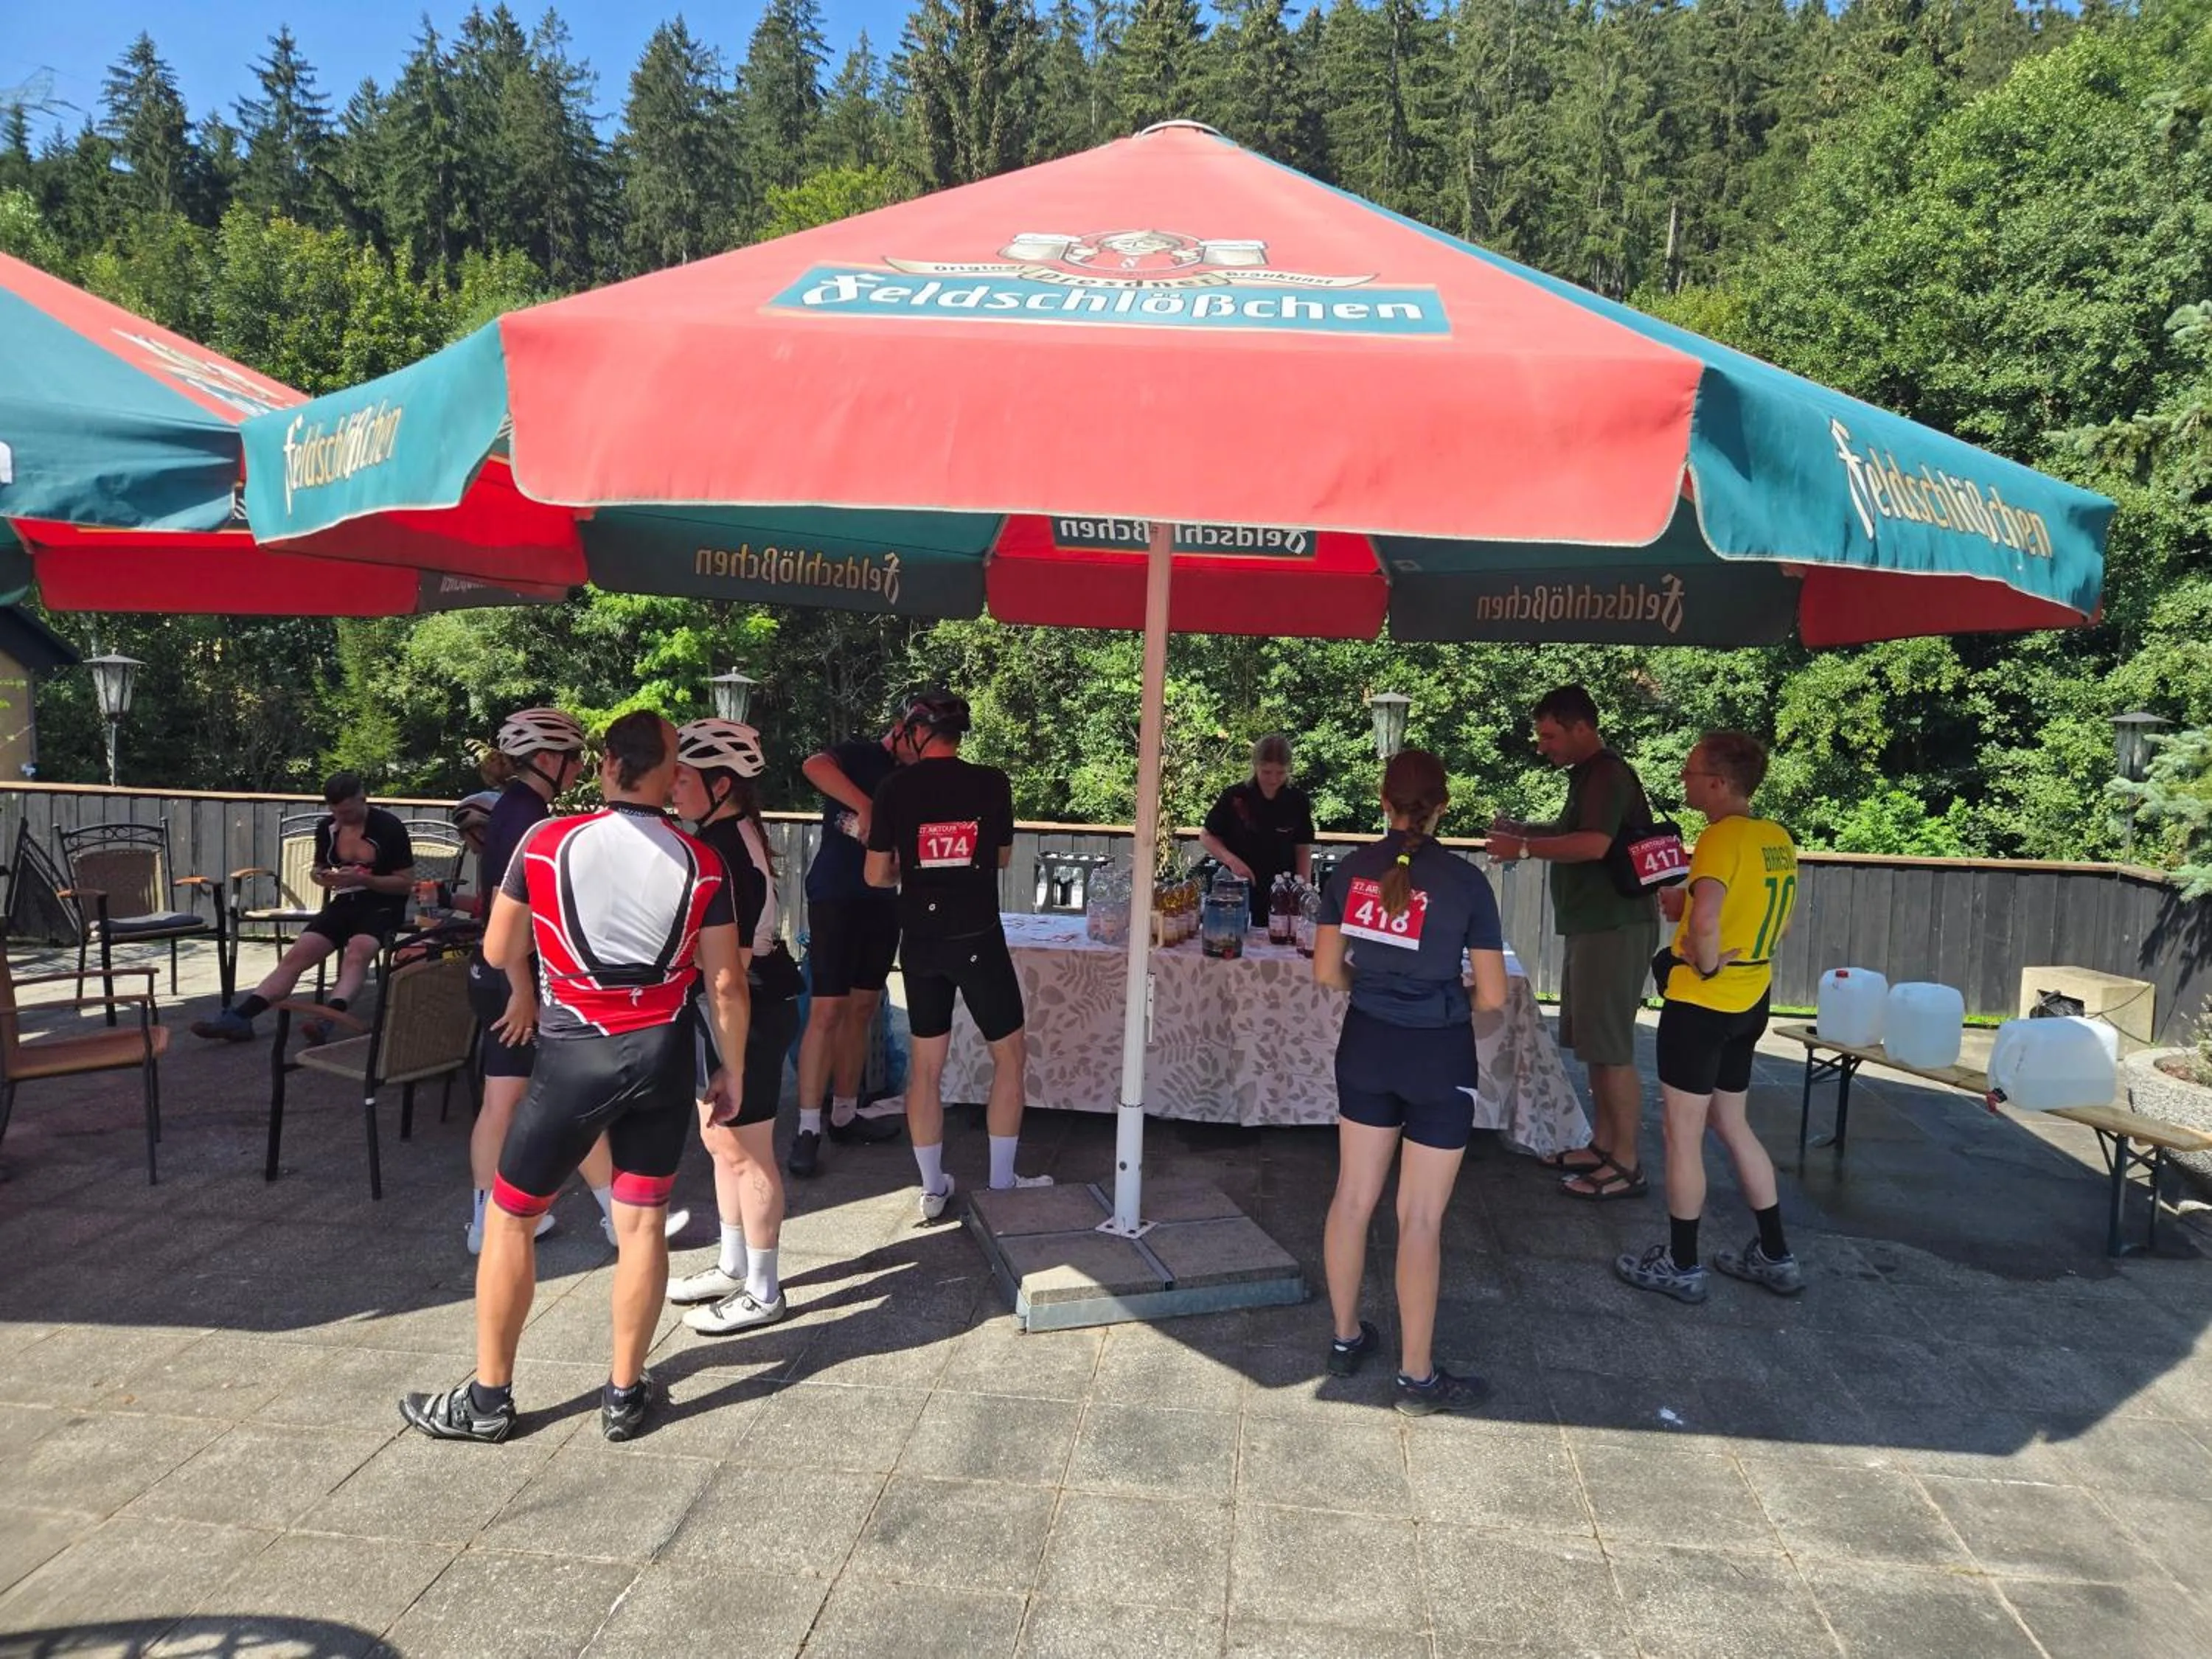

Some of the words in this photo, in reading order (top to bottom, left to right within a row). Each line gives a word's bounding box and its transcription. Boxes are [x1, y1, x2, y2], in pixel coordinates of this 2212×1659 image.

[801, 271, 1424, 319] Feldschlößchen
[1830, 417, 2053, 557] Feldschlößchen
[927, 836, 970, 858] 174
[1645, 849, 1679, 870] 417
